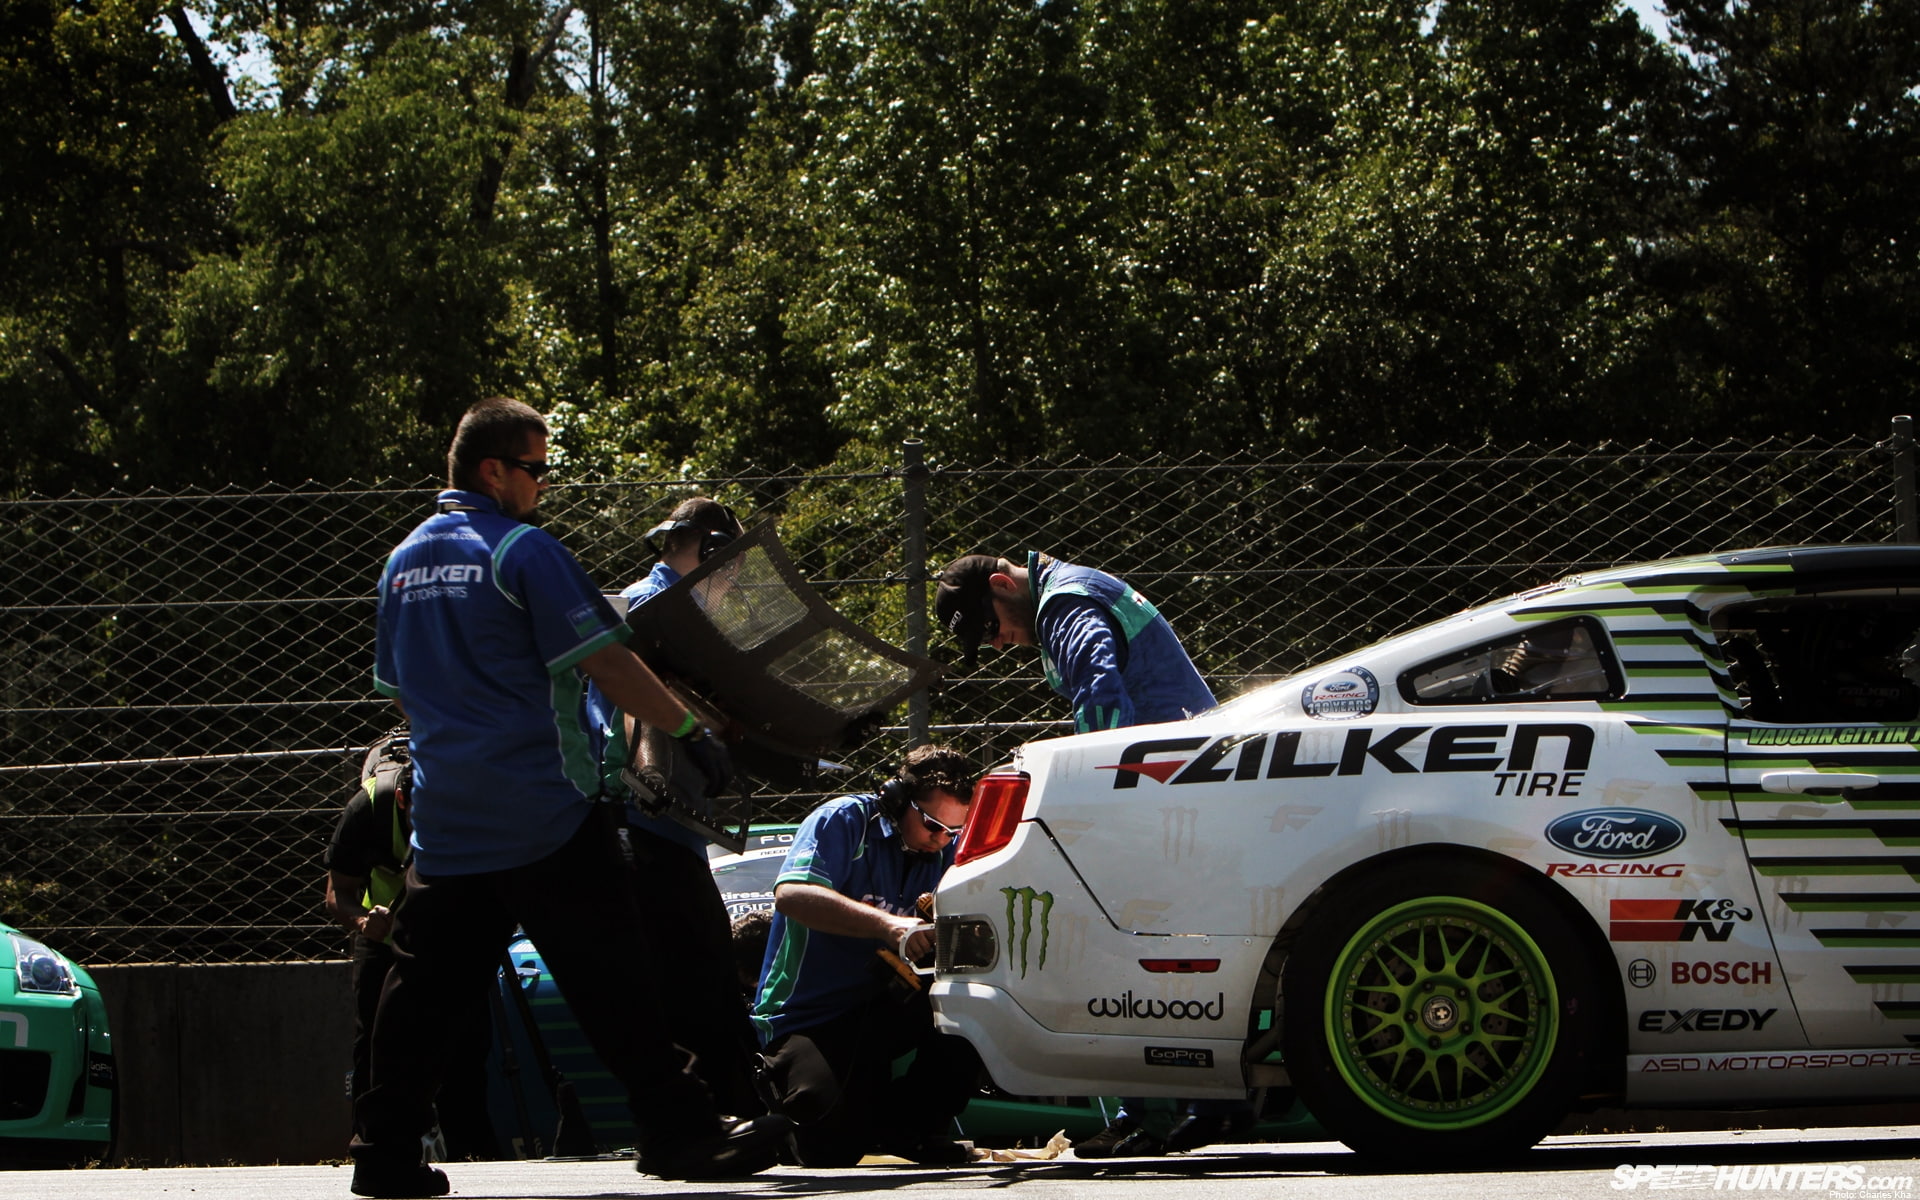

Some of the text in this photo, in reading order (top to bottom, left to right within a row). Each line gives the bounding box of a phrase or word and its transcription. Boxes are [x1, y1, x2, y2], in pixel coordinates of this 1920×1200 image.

[391, 564, 484, 594] FALKEN
[1308, 699, 1372, 714] 110 YEARS
[1314, 692, 1367, 701] RACING
[1748, 727, 1838, 746] VAUGHN
[1838, 727, 1912, 745] GITTIN
[1095, 723, 1595, 789] FALKEN
[1493, 771, 1585, 797] TIRE
[1573, 816, 1656, 850] Ford
[1544, 862, 1686, 878] RACING
[1671, 961, 1771, 985] BOSCH
[1087, 990, 1224, 1021] wilwood
[1637, 1008, 1778, 1034] EXEDY
[1150, 1049, 1206, 1061] GoPro
[1641, 1052, 1920, 1073] ASD MOTORSPORTS
